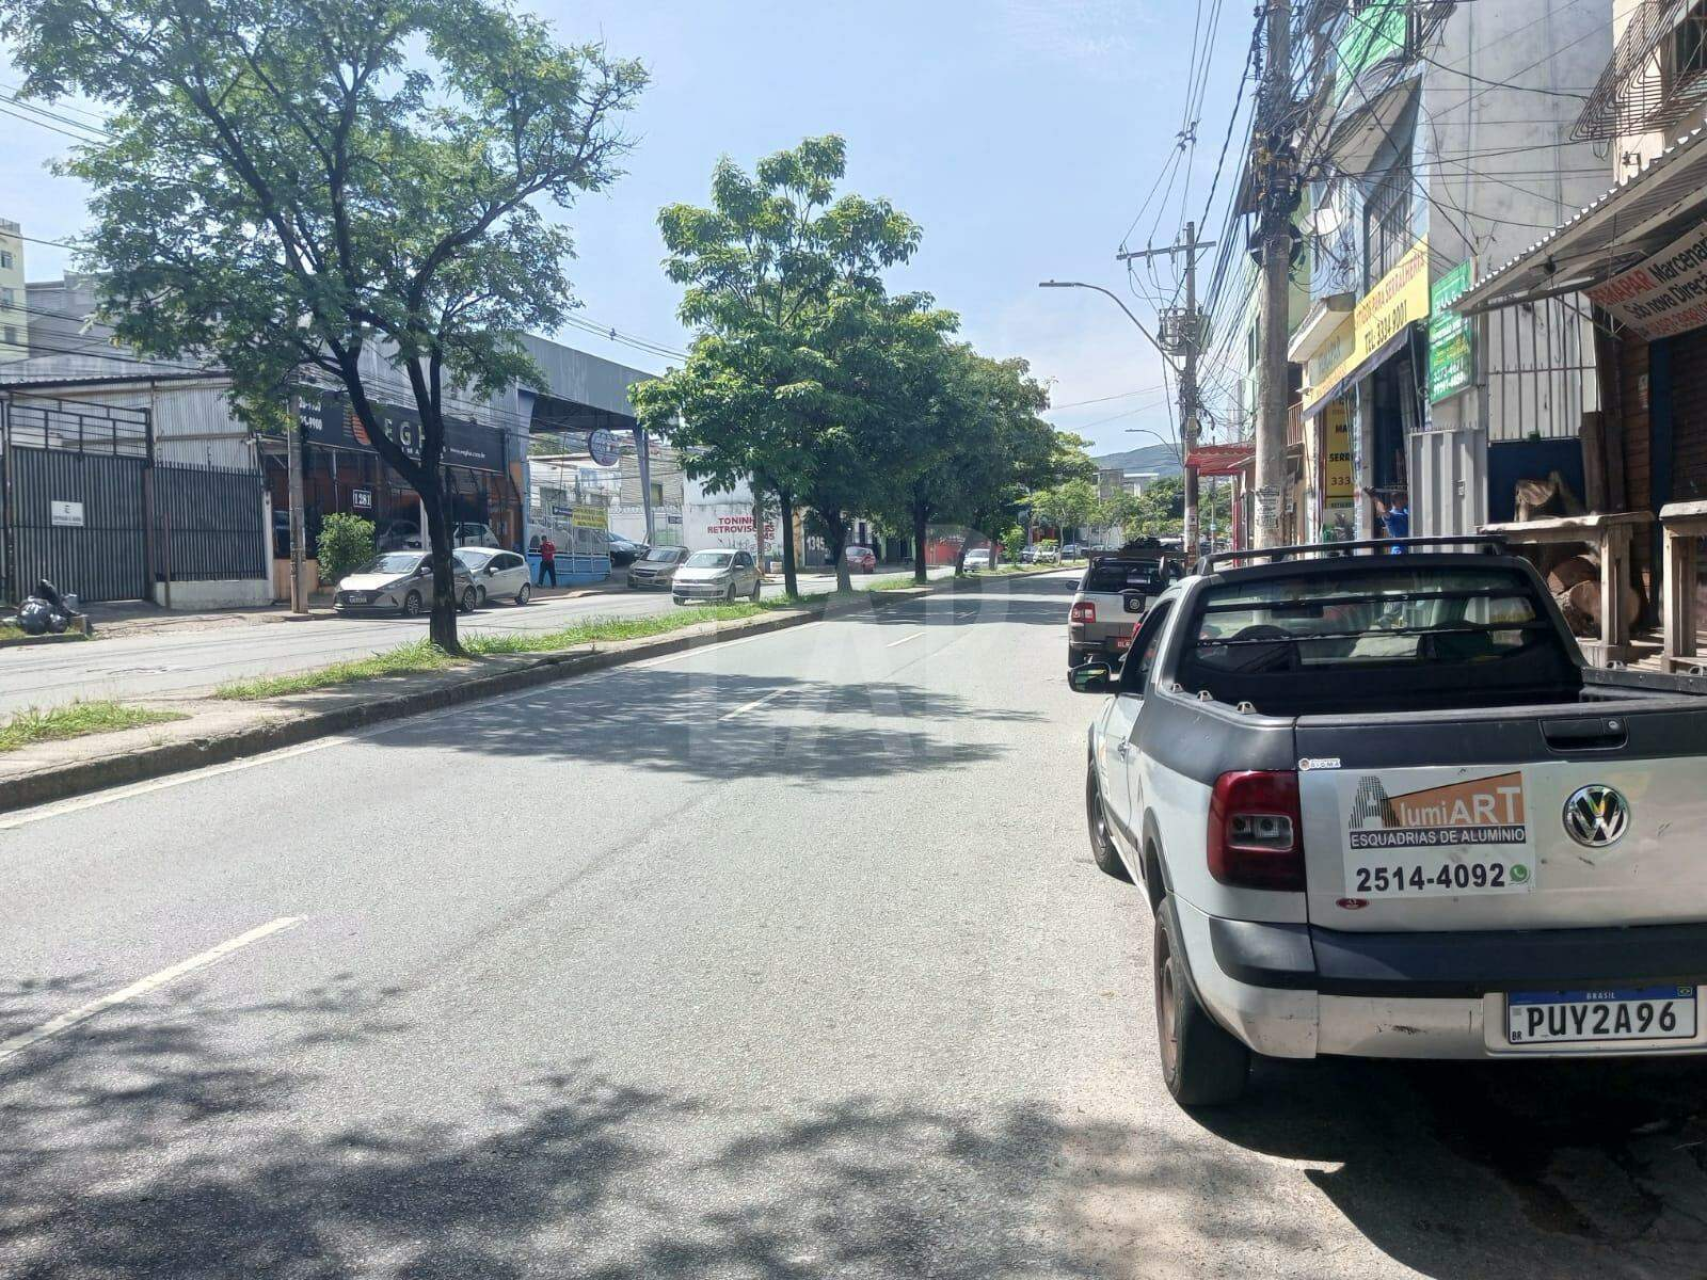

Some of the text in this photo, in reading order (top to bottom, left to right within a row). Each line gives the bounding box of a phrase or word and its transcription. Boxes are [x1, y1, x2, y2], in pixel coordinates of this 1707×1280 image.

[1647, 292, 1678, 313] nova
[1351, 832, 1437, 848] ESQUADRIAS
[1442, 830, 1459, 844] DE
[1356, 862, 1505, 893] 2514-4092
[1586, 991, 1615, 1000] BRASIL
[1526, 1001, 1676, 1038] PUY2A96
[1512, 1031, 1522, 1041] BR
